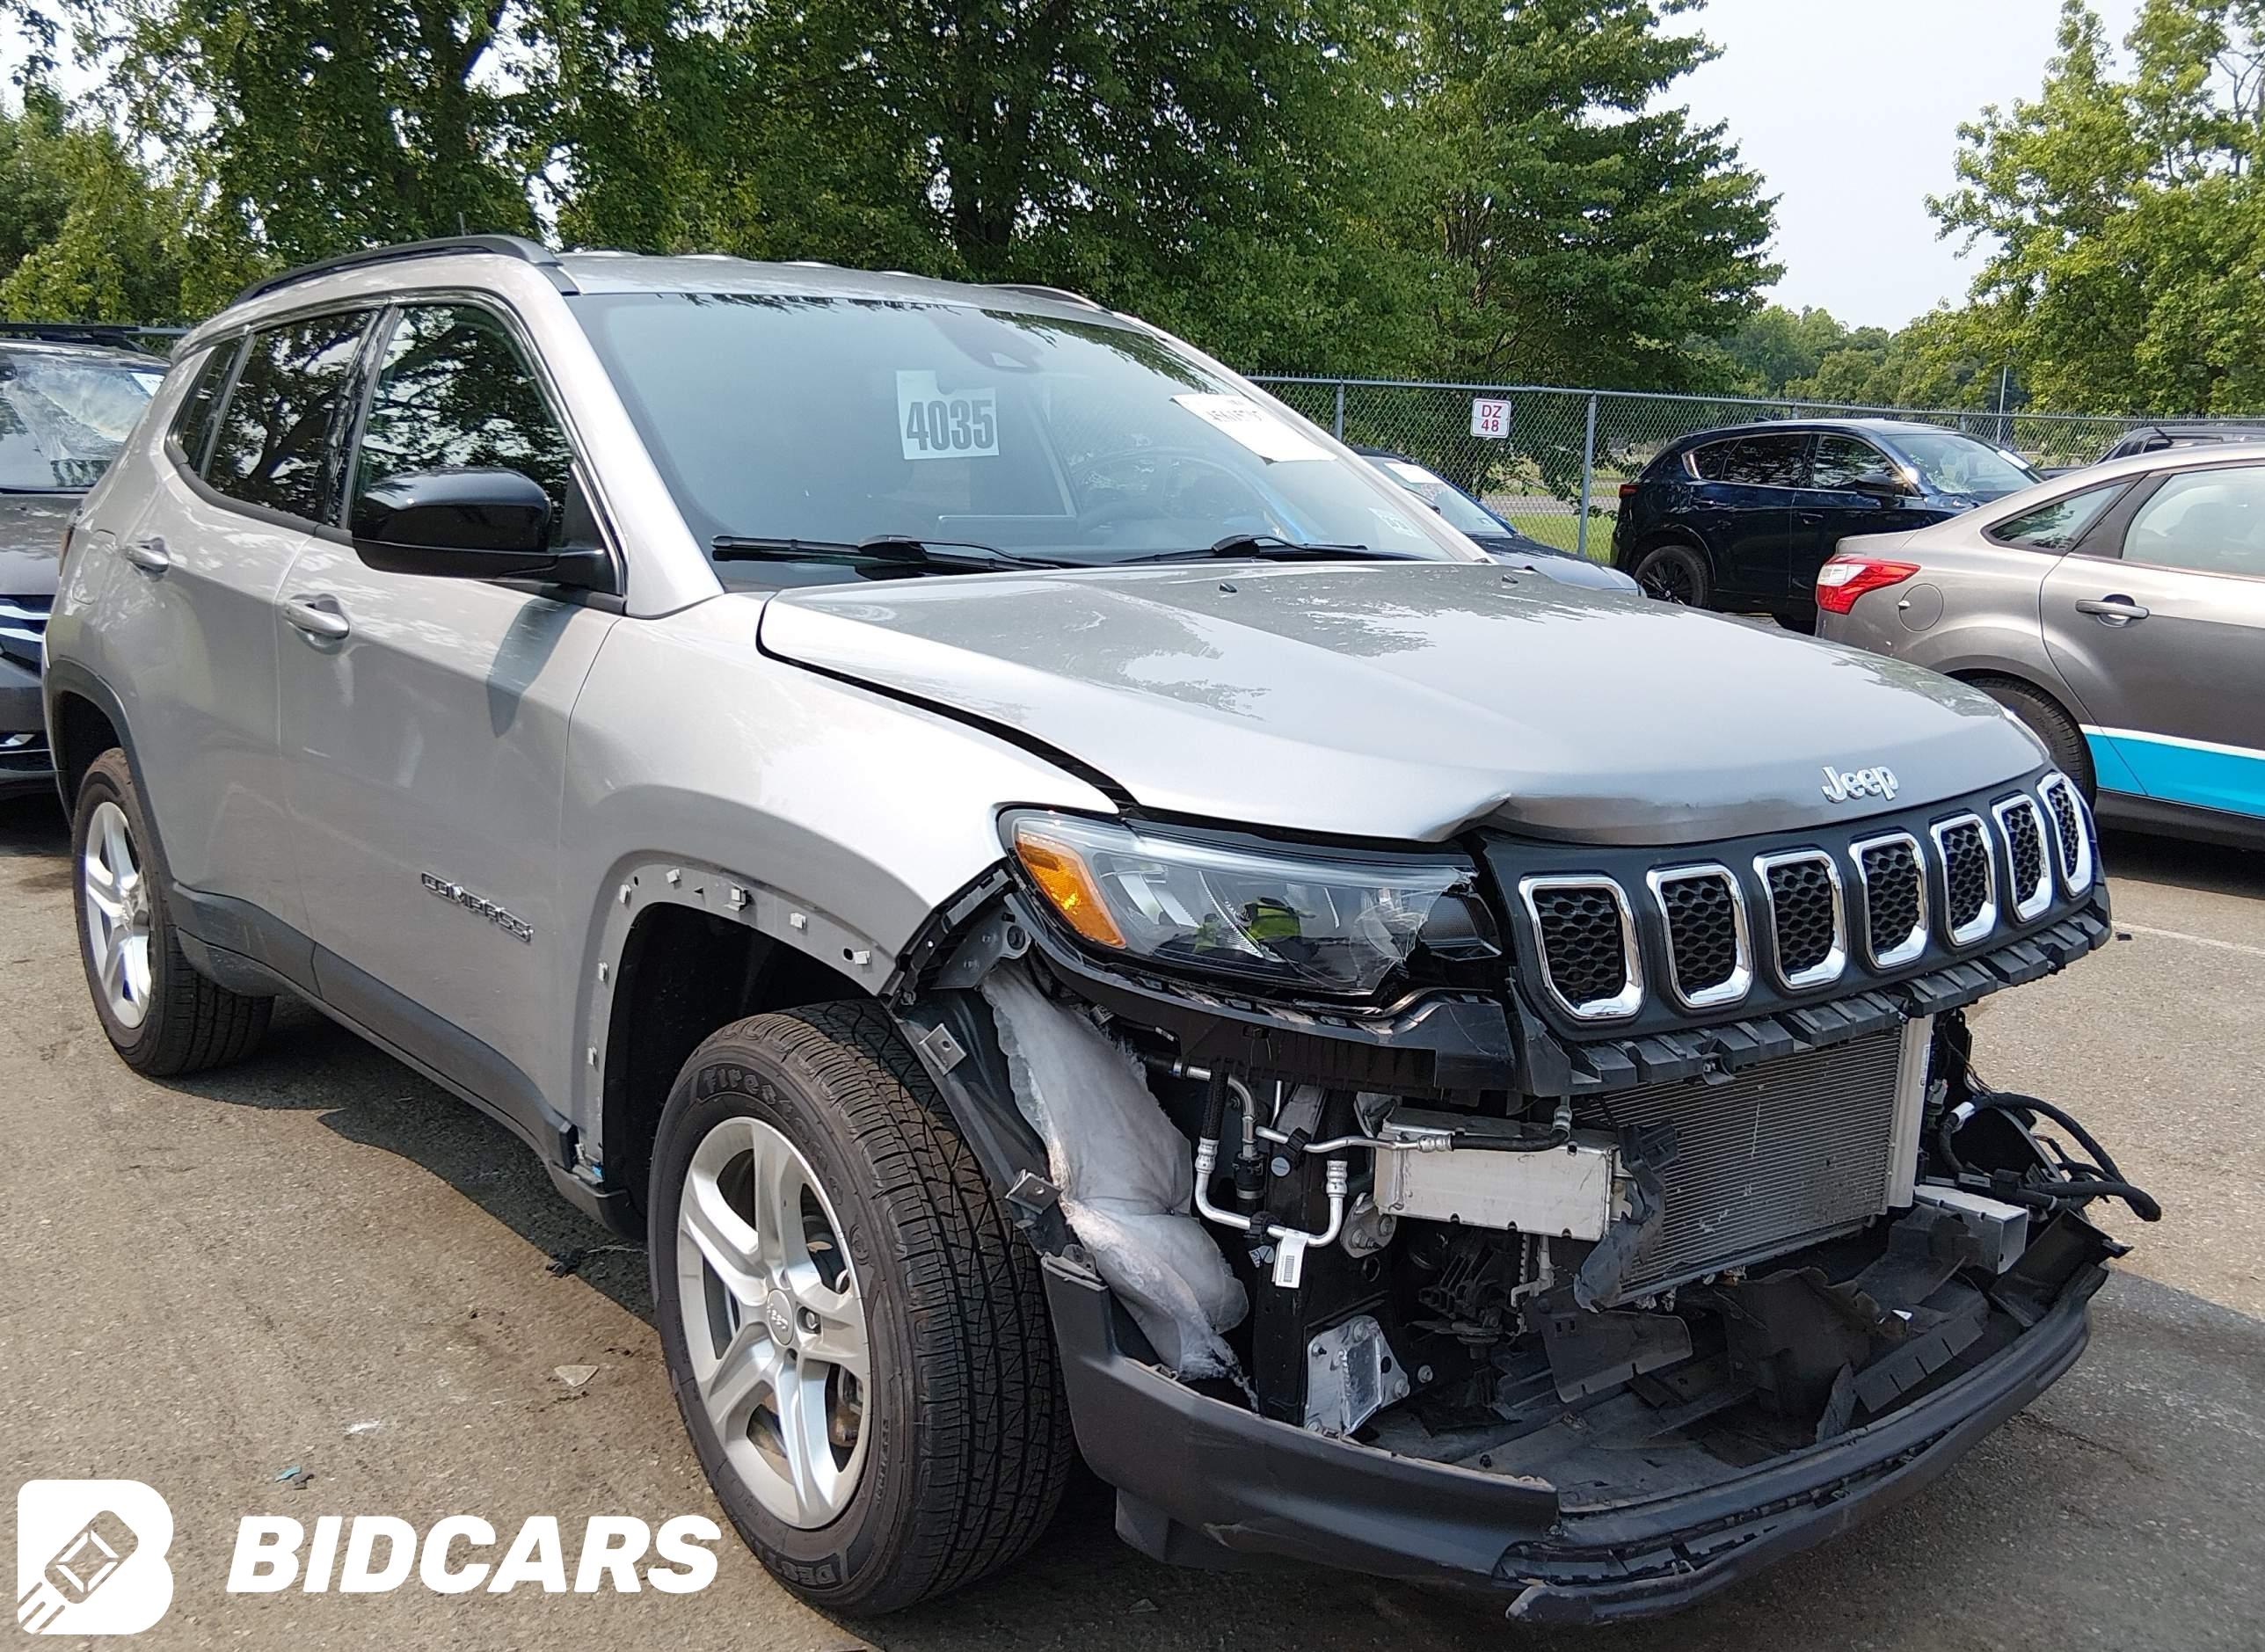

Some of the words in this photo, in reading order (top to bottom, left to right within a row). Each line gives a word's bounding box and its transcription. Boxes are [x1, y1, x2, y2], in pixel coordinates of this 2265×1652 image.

[1482, 404, 1503, 418] DZ
[907, 399, 994, 451] 4035
[1481, 419, 1499, 433] 48
[1821, 766, 1899, 804] Jeep
